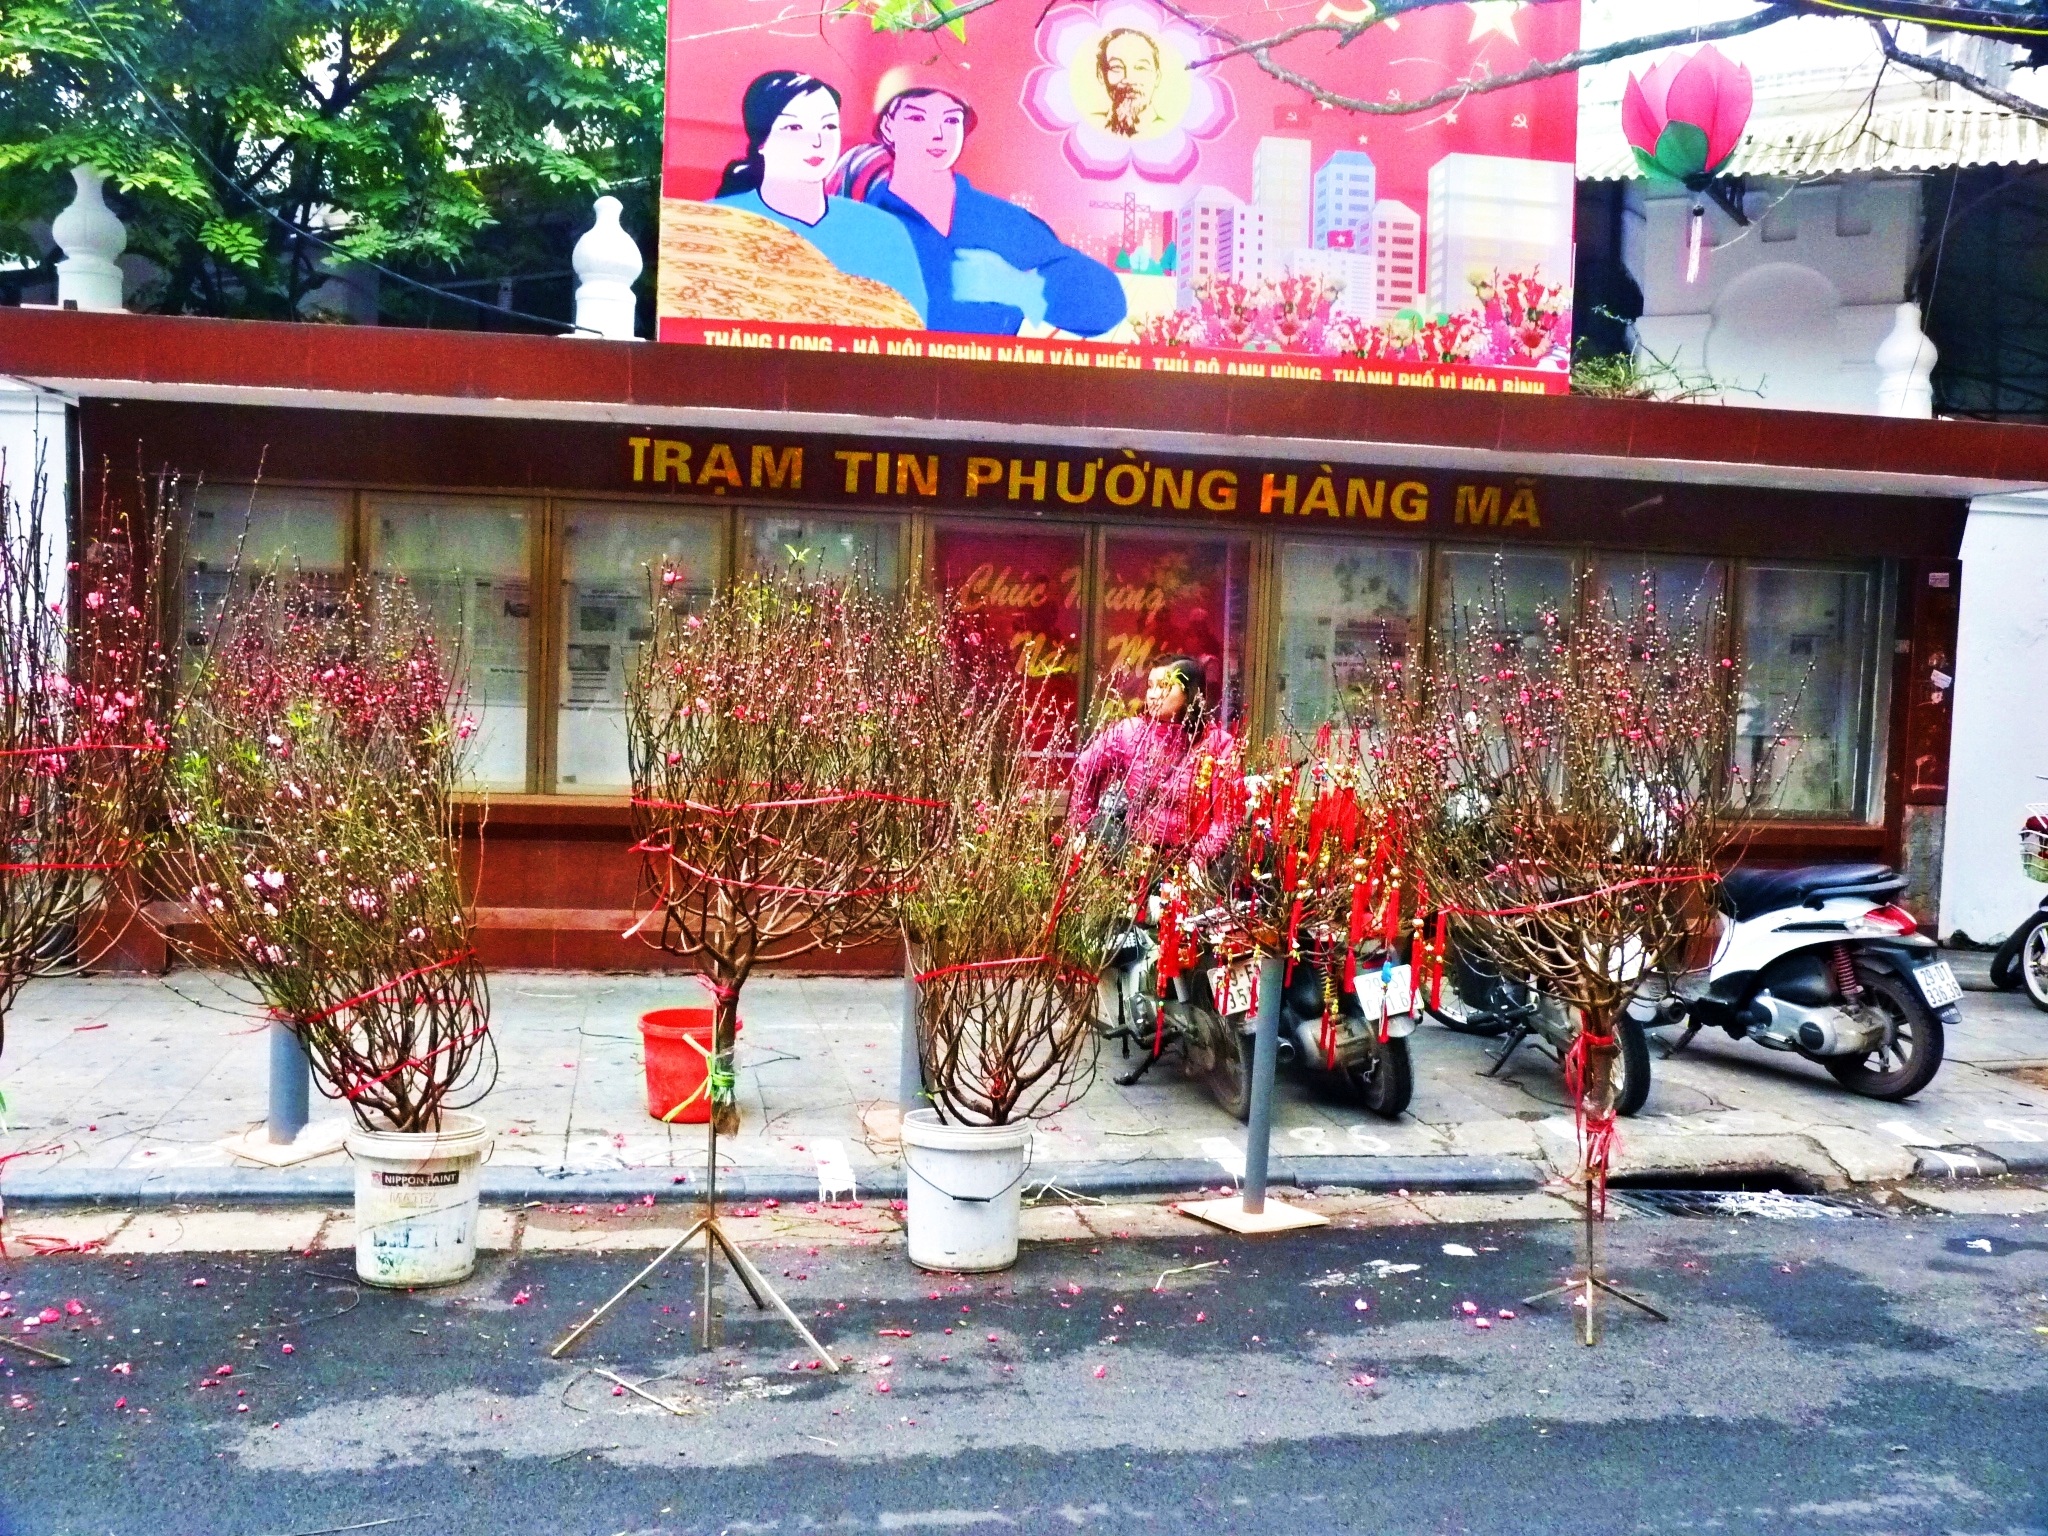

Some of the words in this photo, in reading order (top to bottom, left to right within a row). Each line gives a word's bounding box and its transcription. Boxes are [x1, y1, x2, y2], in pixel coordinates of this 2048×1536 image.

[704, 328, 772, 349] THĂNG
[853, 335, 880, 355] HÀ
[928, 341, 991, 361] NGHÌN
[997, 344, 1045, 364] NĂM
[1050, 347, 1090, 367] VĂN
[1227, 362, 1265, 377] ANH
[1333, 366, 1393, 385] THÀNH
[628, 437, 803, 495] TRẠM
[834, 450, 939, 496] TIN
[965, 449, 1238, 511] PHƯỜNG
[1260, 464, 1429, 522] HÀNG
[1454, 477, 1541, 528] MÃ
[384, 1174, 425, 1185] NIPPON
